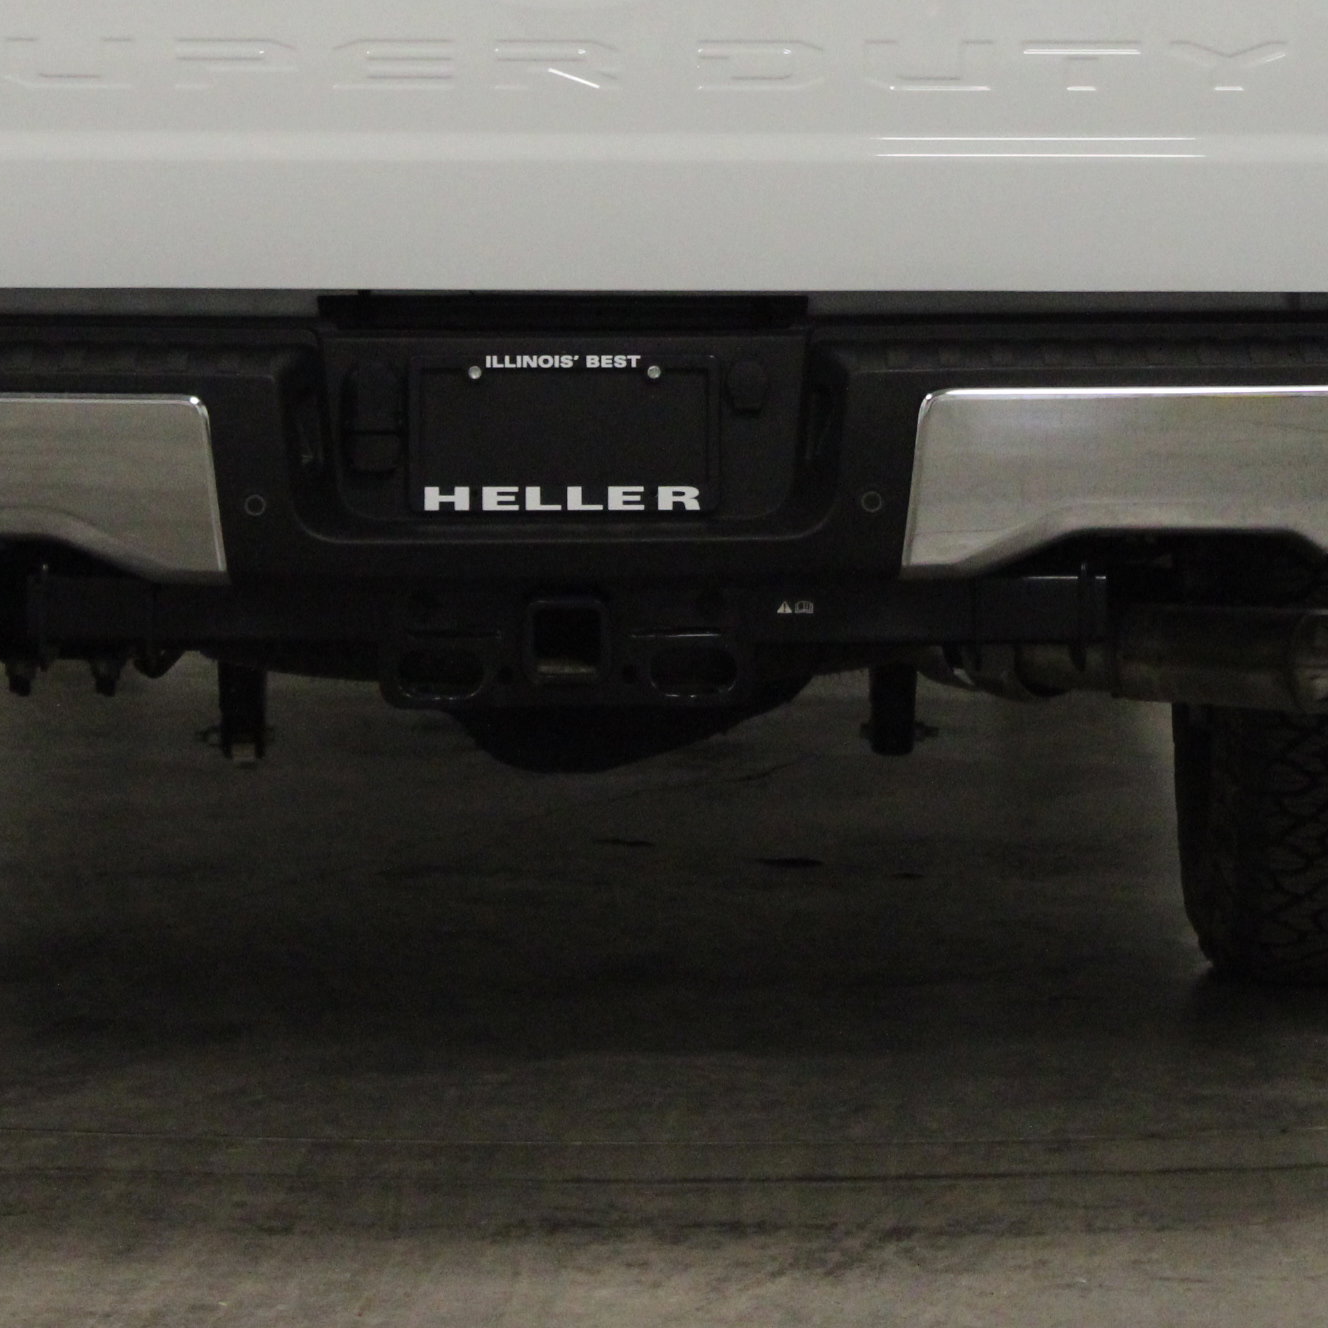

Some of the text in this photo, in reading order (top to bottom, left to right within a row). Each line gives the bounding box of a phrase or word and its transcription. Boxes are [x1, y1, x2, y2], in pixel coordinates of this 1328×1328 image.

[695, 38, 1288, 91] DUTY
[485, 354, 641, 369] ILLINOIS' BEST
[423, 485, 701, 511] HELLER
